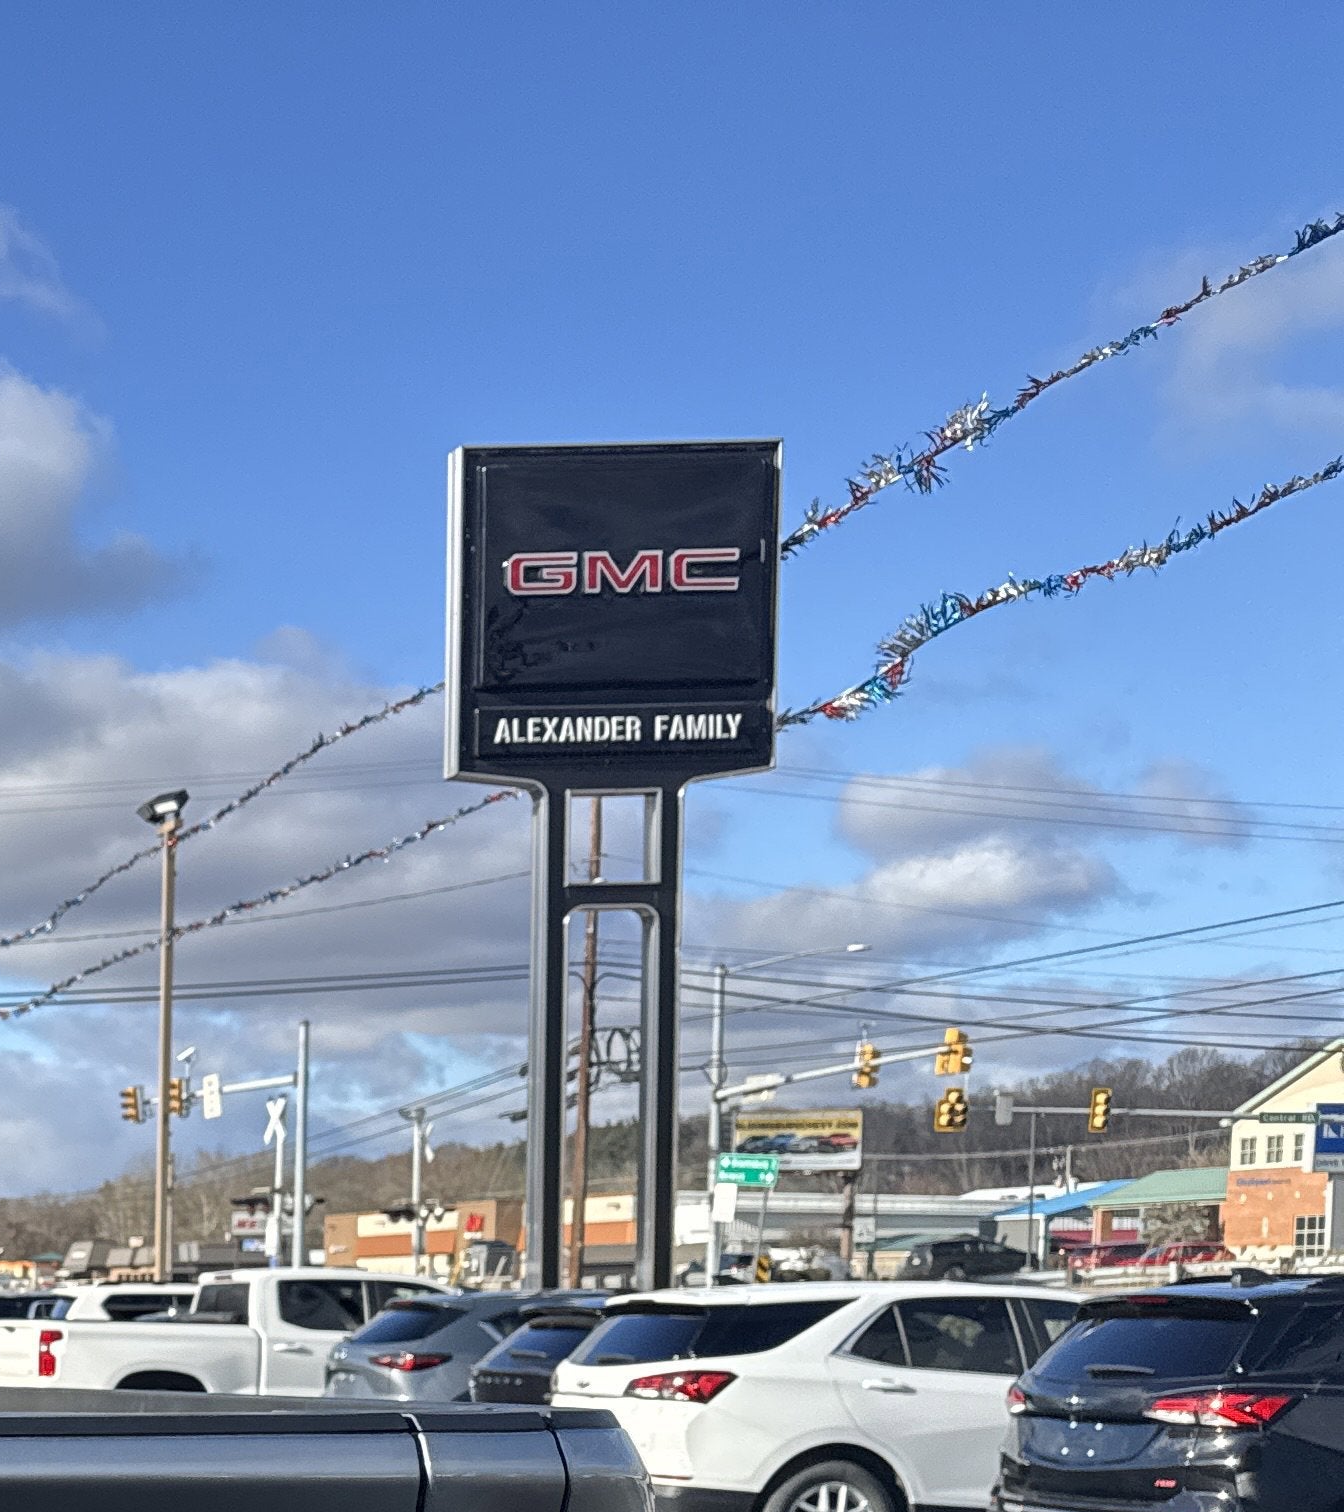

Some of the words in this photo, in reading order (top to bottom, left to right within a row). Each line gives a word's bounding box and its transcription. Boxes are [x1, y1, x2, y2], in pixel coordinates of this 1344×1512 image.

[506, 547, 741, 595] GMC
[493, 715, 642, 745] ALEXANDER
[654, 713, 743, 741] FAMILY
